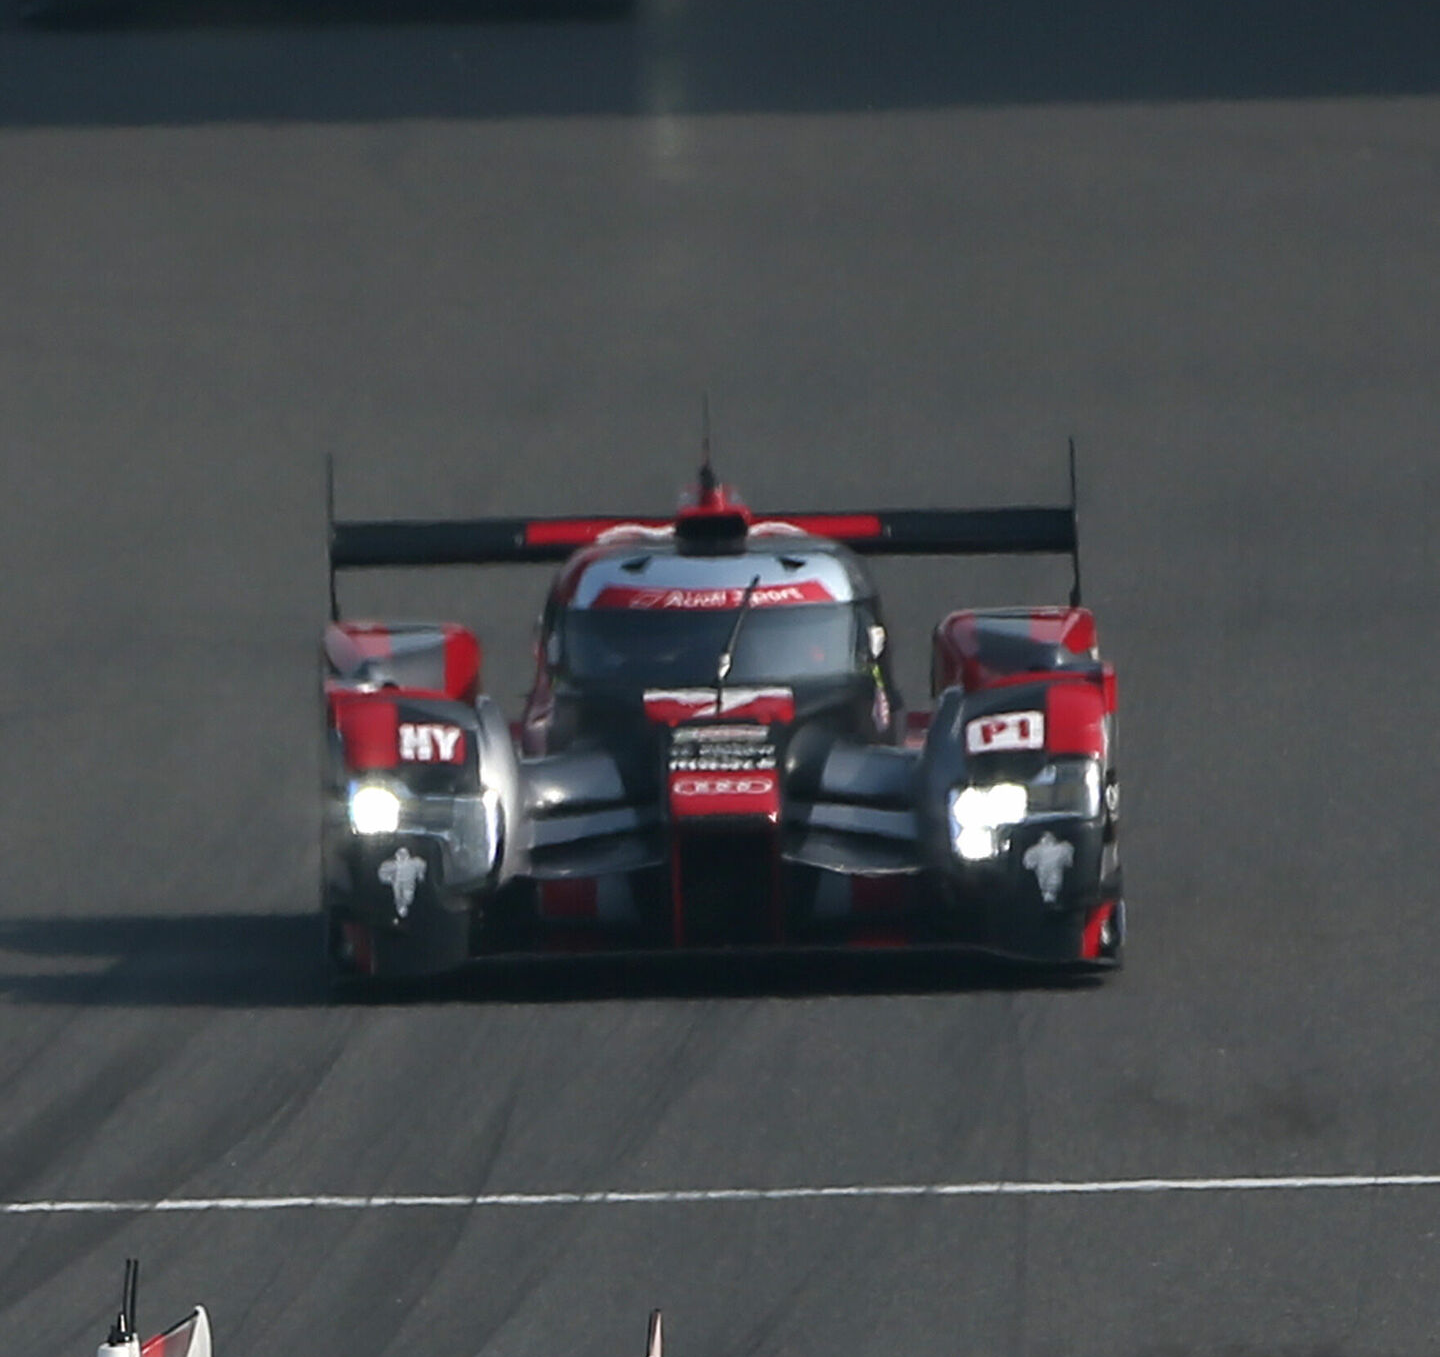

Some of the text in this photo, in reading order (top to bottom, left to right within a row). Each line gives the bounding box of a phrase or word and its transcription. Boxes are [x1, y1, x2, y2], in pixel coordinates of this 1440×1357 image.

[664, 590, 727, 608] Audi
[399, 723, 460, 761] HY
[981, 718, 1031, 745] P1
